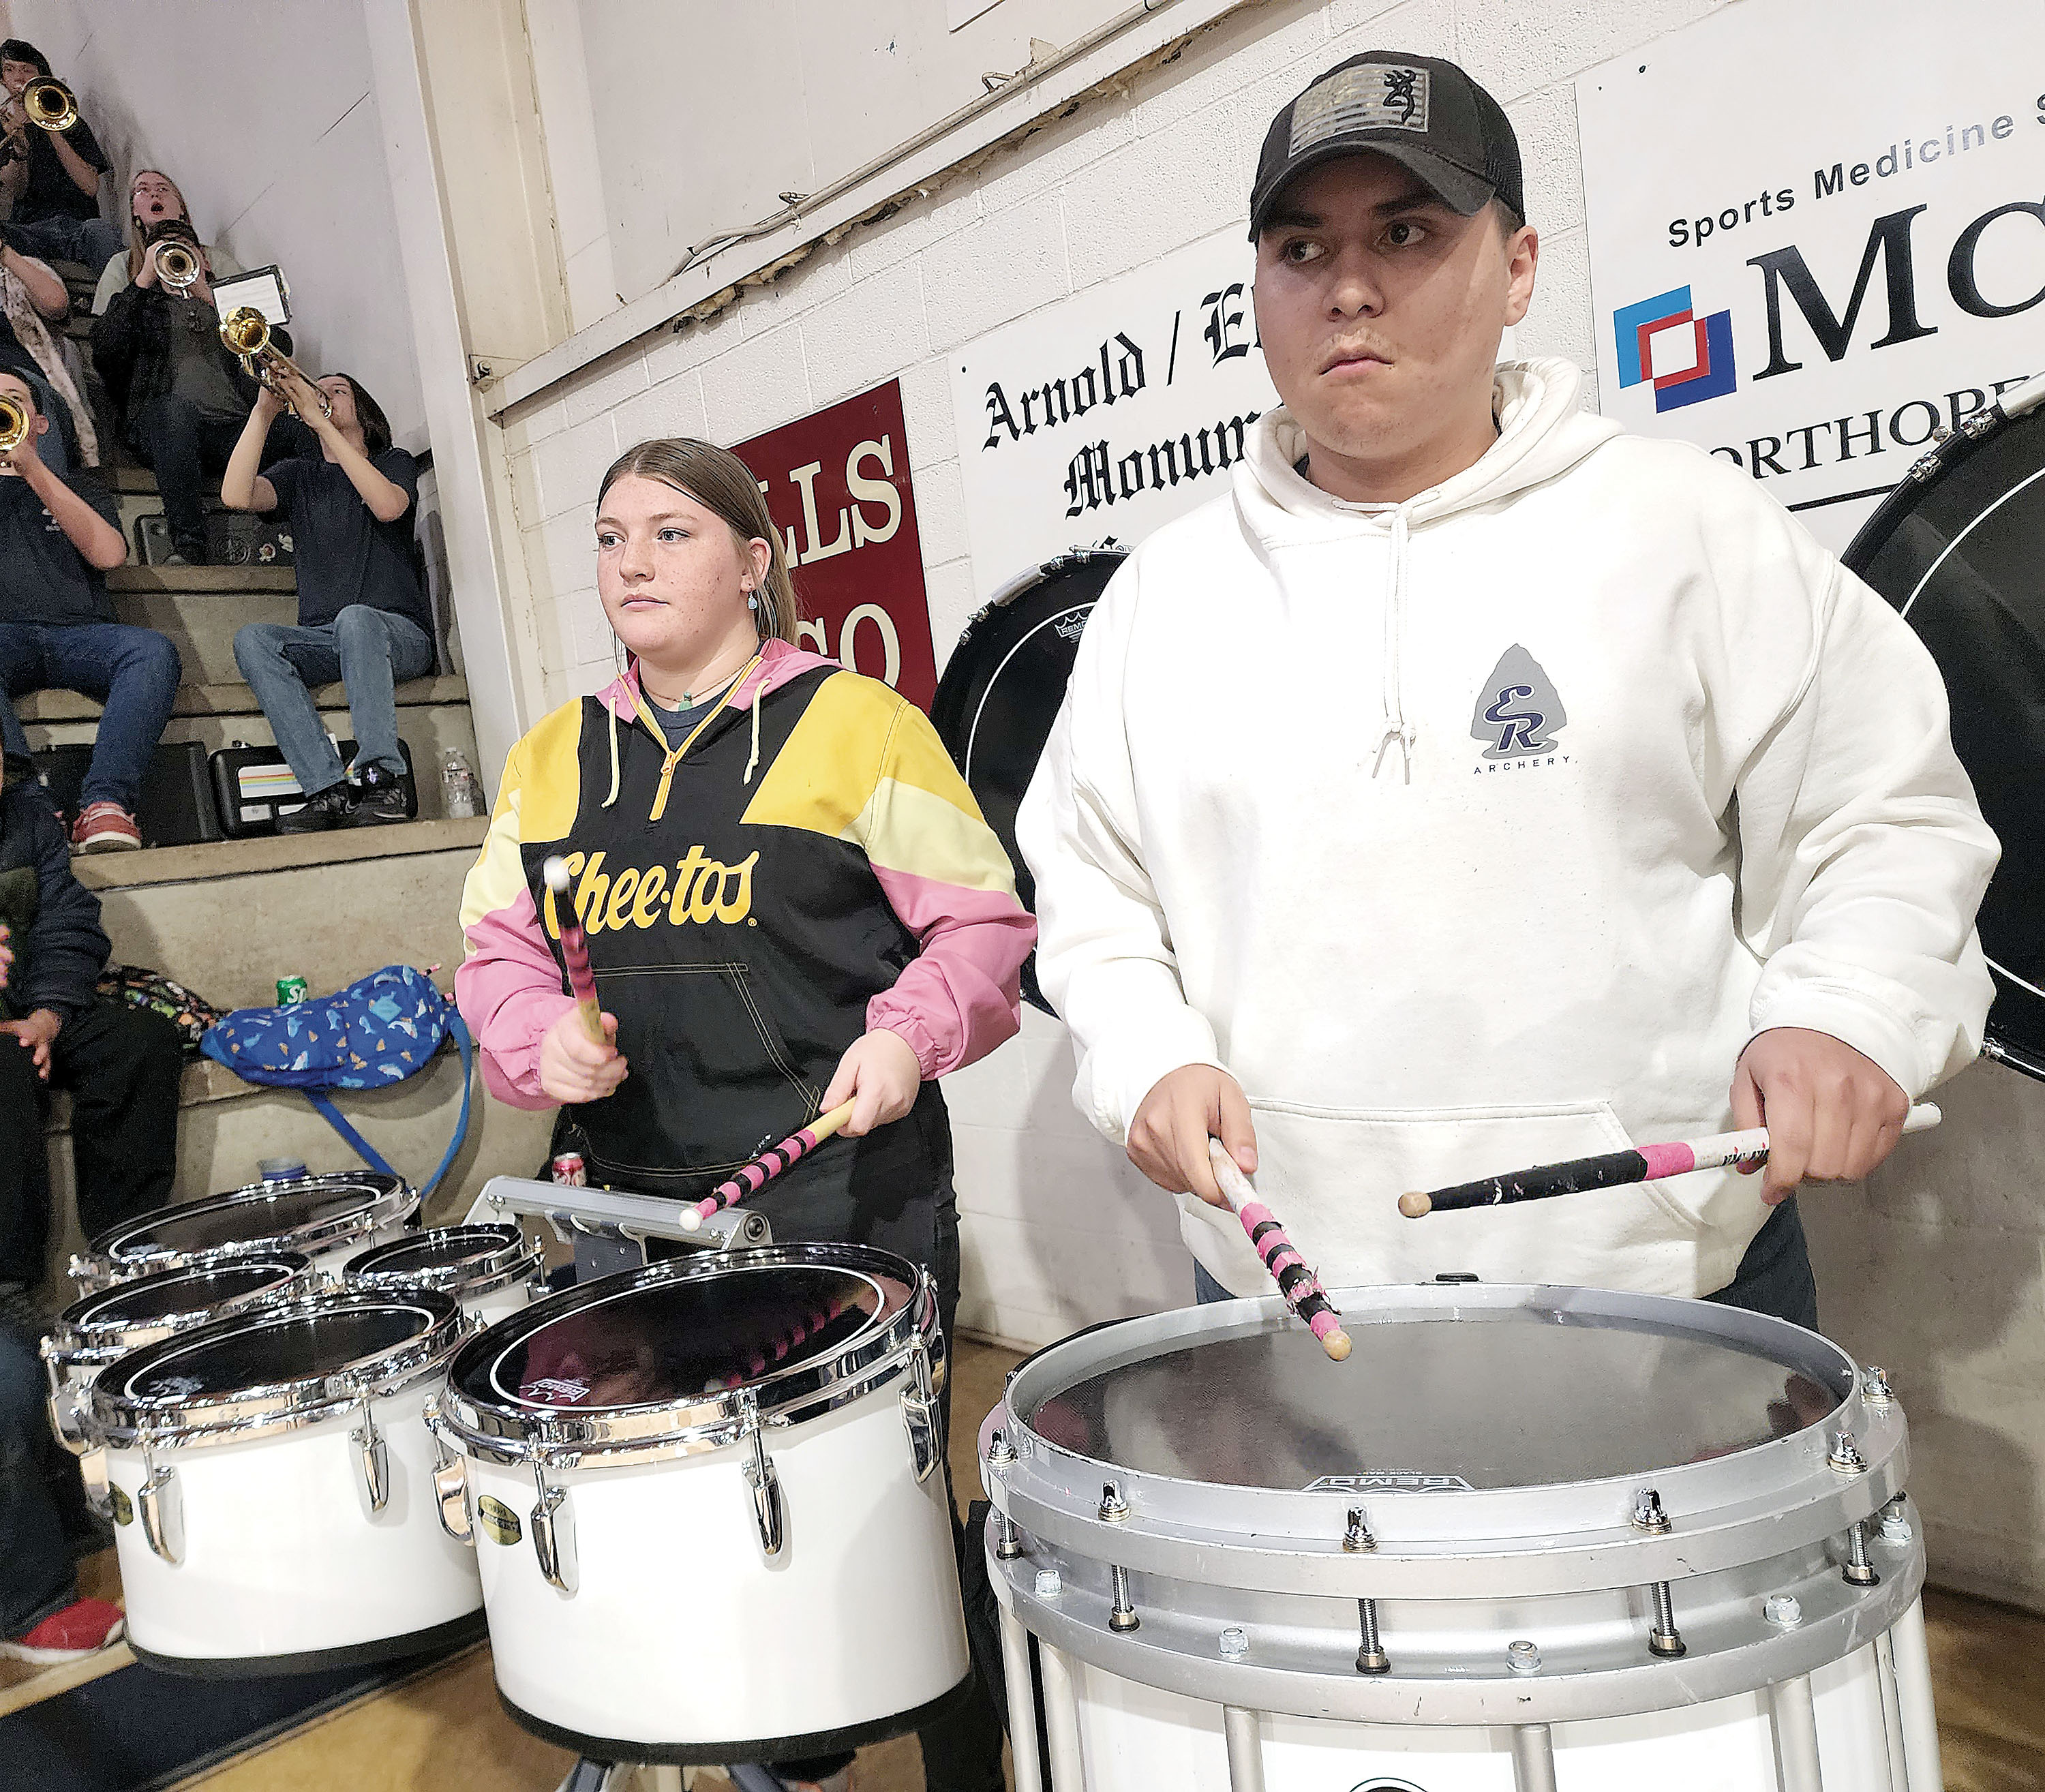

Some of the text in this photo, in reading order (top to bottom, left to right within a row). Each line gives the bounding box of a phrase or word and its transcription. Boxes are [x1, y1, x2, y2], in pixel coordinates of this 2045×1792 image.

[1669, 113, 2014, 247] Sports Medicine
[982, 282, 1264, 453] Arnold / E
[757, 434, 903, 569] LS
[796, 603, 900, 689] O
[1474, 755, 1570, 775] ARCHERY
[1329, 1478, 1451, 1486] REMO
